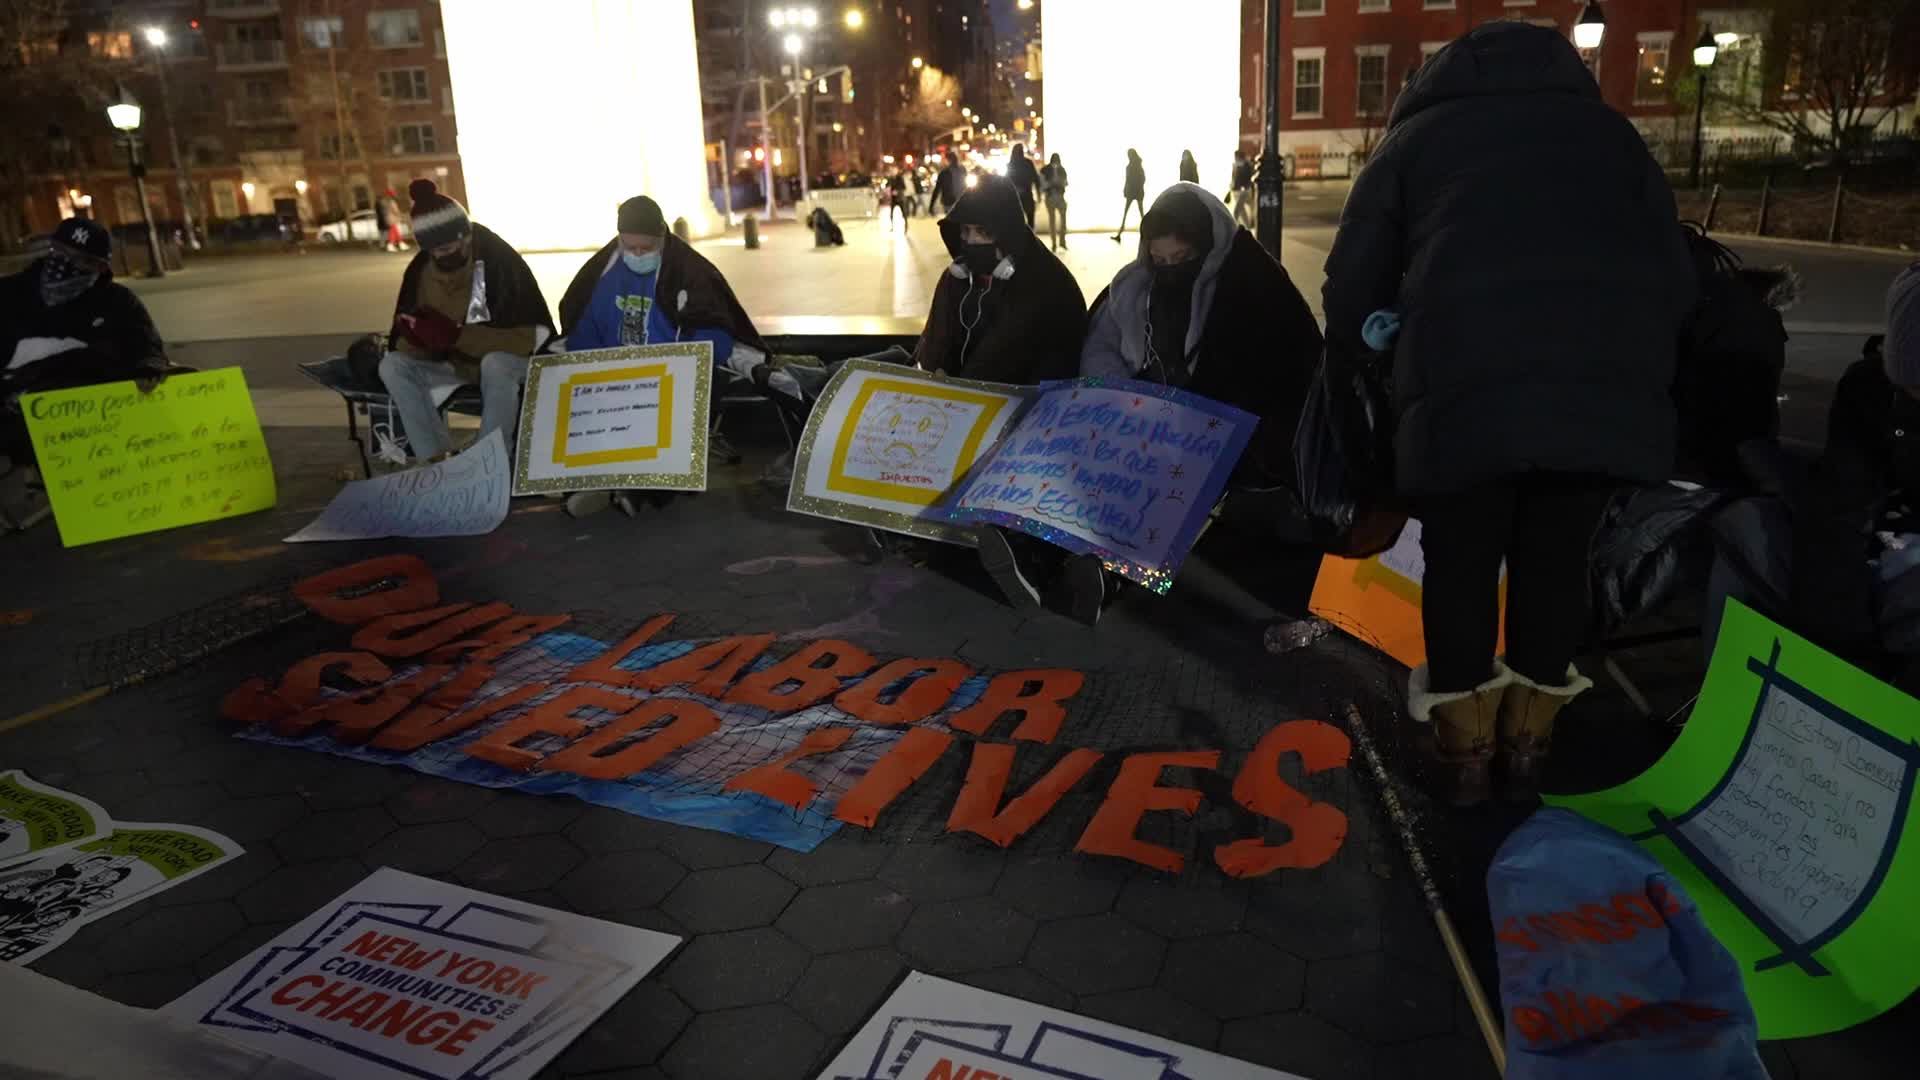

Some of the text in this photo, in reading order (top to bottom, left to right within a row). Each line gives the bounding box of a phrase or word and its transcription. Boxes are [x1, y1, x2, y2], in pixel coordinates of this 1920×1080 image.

[292, 553, 1085, 744] OUR LABOR
[218, 650, 1353, 879] SAVED LIVES
[128, 832, 177, 845] THE
[168, 838, 214, 863] ROAD
[319, 957, 505, 1016] COMMUNITIES
[342, 930, 549, 1000] NEW YORK
[270, 975, 496, 1057] CHANGE
